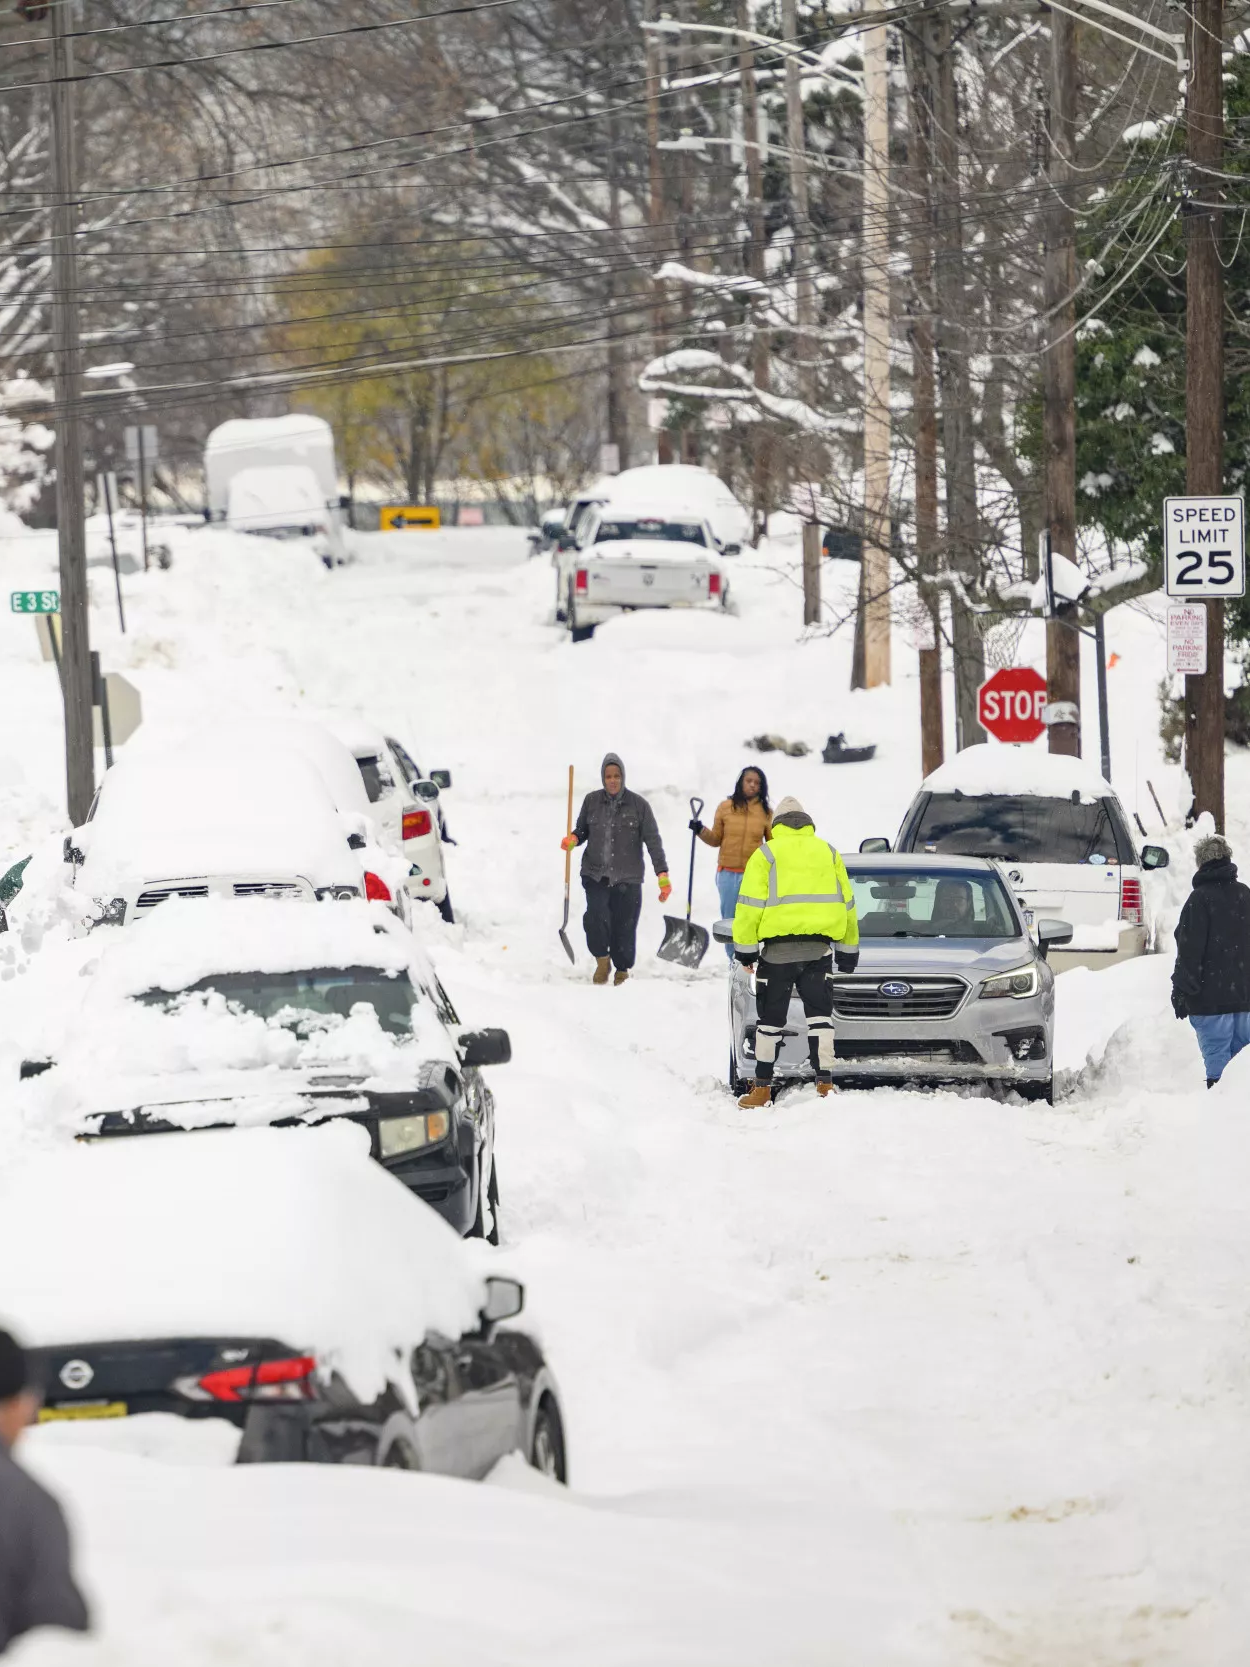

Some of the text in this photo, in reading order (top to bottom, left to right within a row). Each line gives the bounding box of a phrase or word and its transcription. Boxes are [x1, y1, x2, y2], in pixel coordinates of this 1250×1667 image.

[1173, 507, 1236, 523] SPEED
[1179, 528, 1229, 544] LIMIT
[1175, 550, 1235, 585] 25
[12, 592, 57, 611] E 3 St
[984, 690, 1048, 720] STOP
